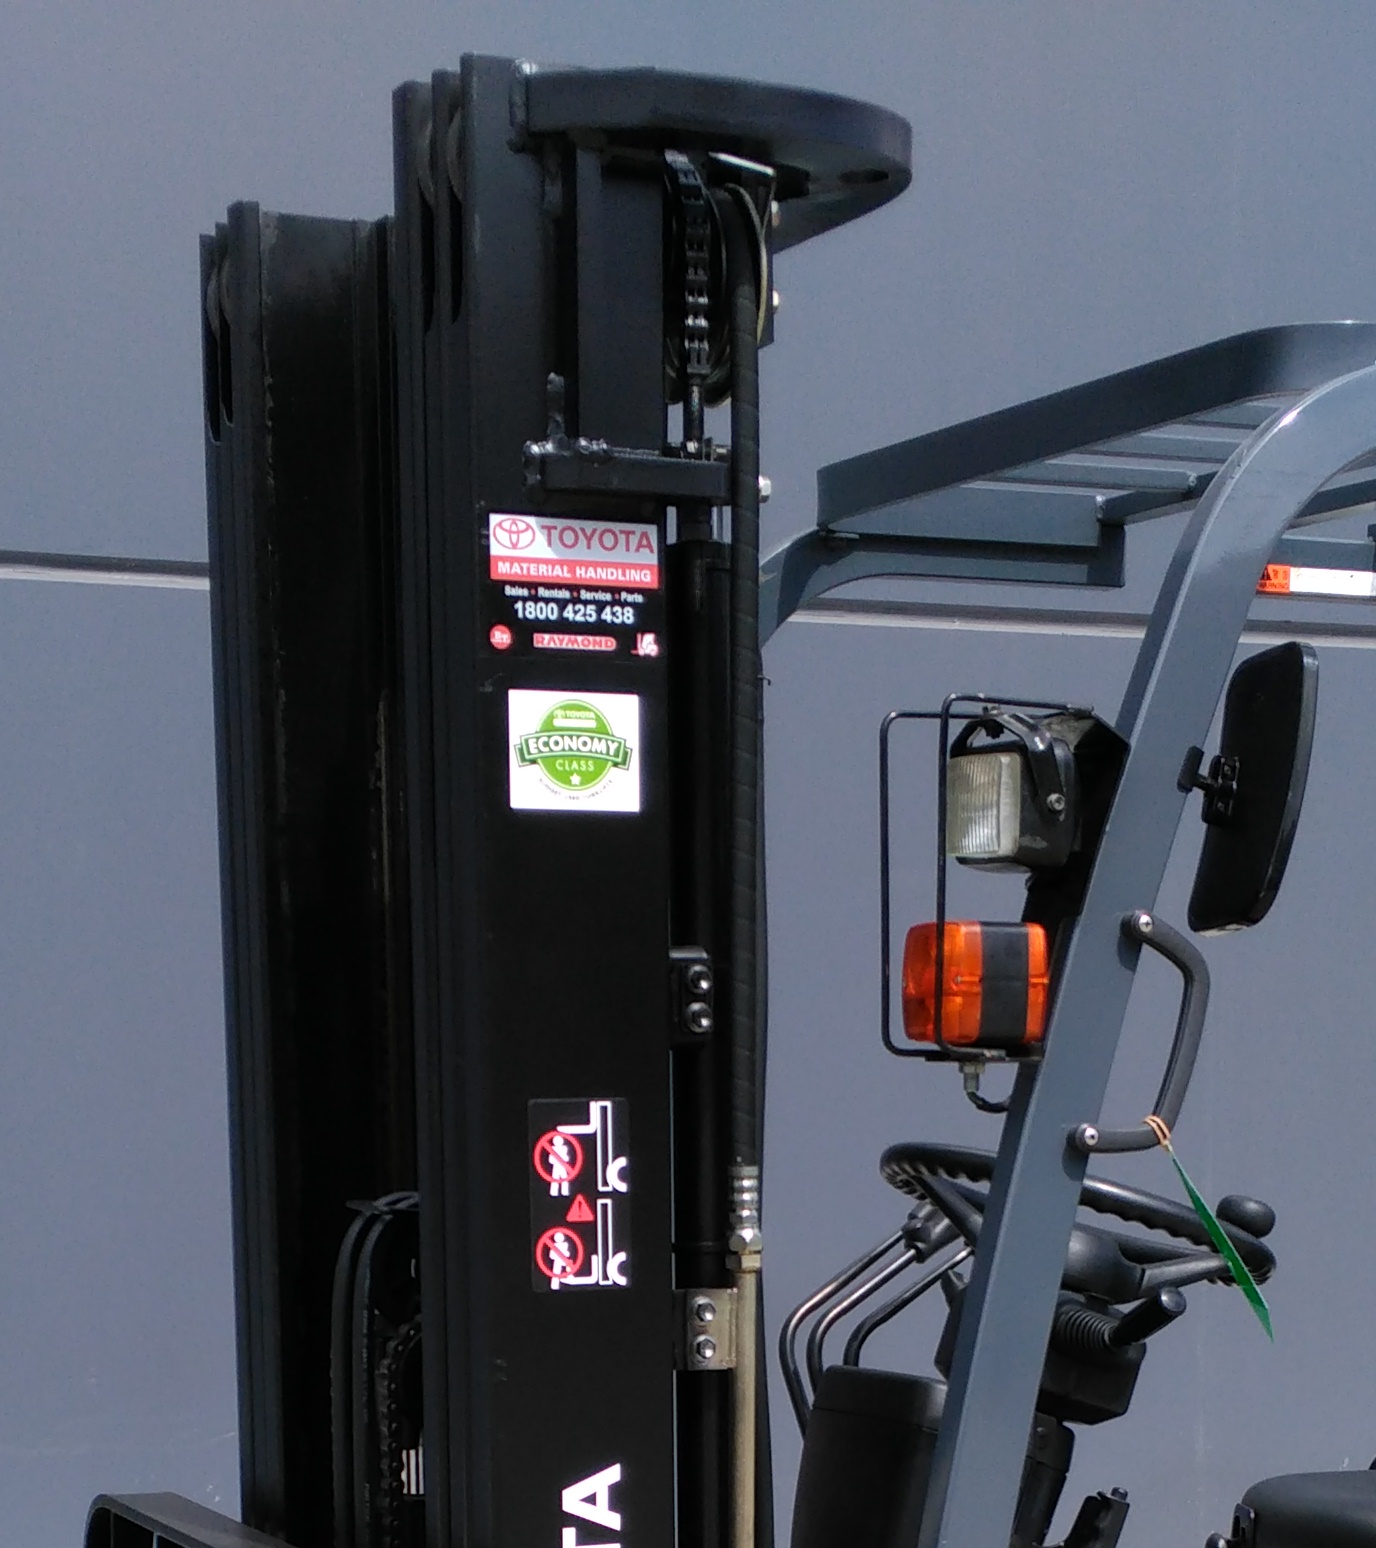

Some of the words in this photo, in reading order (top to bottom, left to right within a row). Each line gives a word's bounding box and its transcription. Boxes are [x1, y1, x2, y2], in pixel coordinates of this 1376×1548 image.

[541, 525, 654, 554] TOYOTA
[497, 561, 571, 578] MATERIAL
[576, 565, 651, 582] HANDLING
[505, 585, 528, 597] Sales
[538, 588, 570, 600] Rentals
[580, 589, 611, 601] Service
[621, 591, 643, 603] Parts
[514, 601, 558, 621] 1800
[563, 603, 596, 623] 425
[600, 605, 634, 624] 438
[535, 635, 615, 649] RAYMOND
[565, 711, 595, 719] TOYOTA
[528, 736, 619, 756] ECONOMY
[556, 759, 595, 772] CLASS
